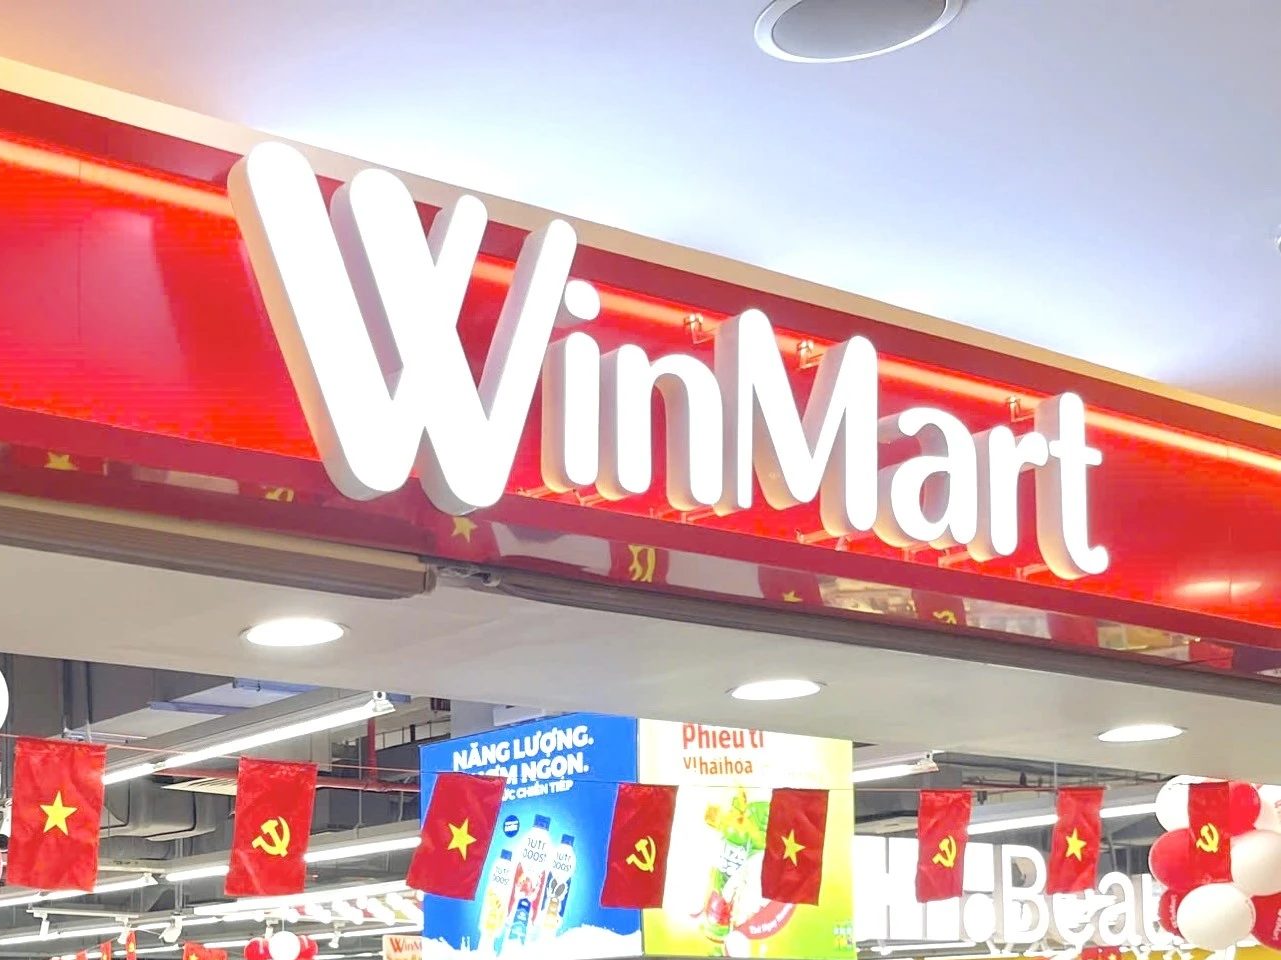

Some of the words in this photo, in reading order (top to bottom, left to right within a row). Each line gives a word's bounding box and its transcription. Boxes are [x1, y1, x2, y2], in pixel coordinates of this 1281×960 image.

[228, 141, 1109, 580] WinMart
[453, 741, 510, 771] NĂNG
[513, 725, 594, 759] LƯỢNG.
[521, 752, 589, 782] NGON.
[390, 937, 422, 953] WinM
